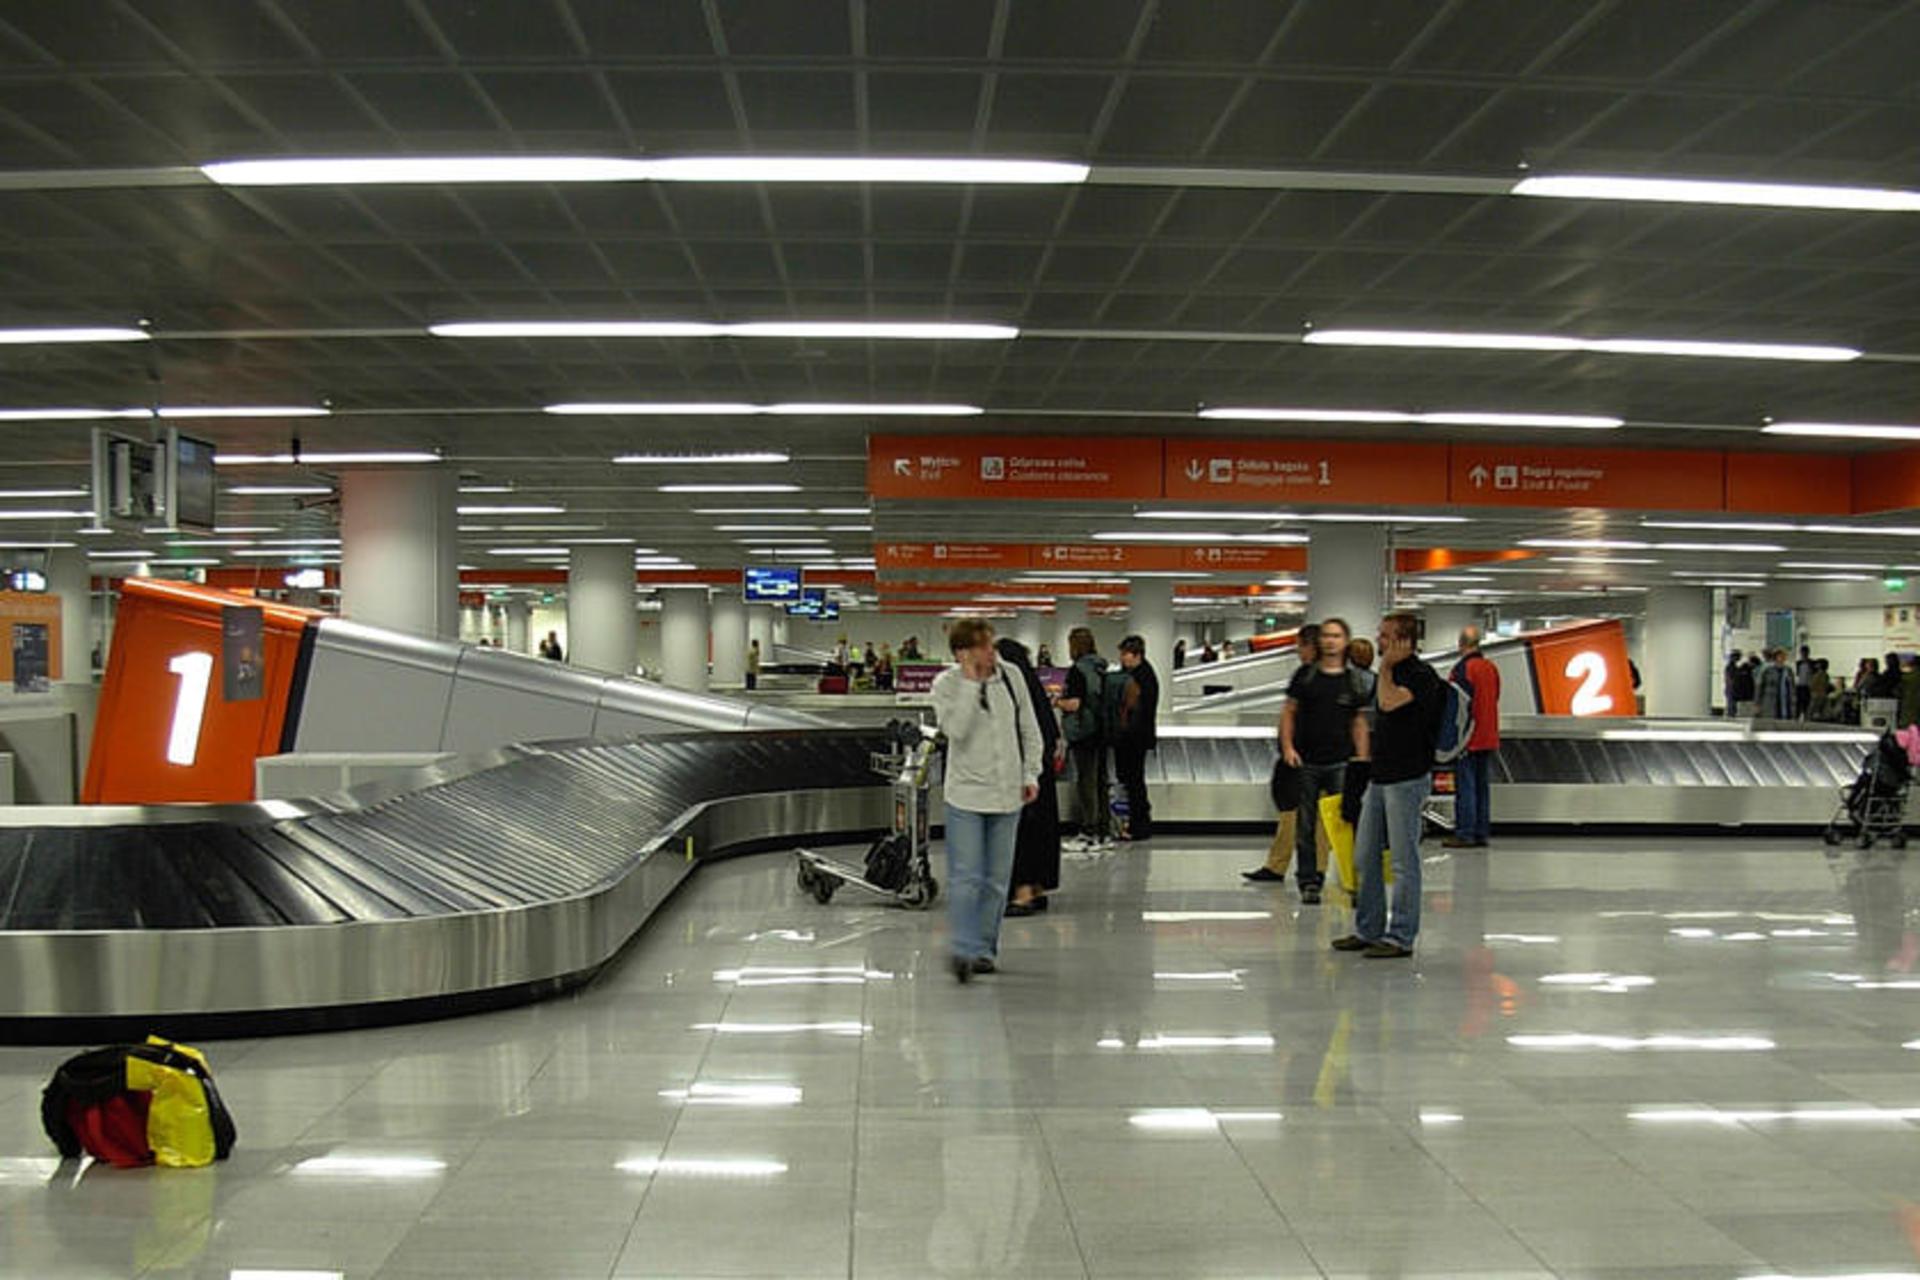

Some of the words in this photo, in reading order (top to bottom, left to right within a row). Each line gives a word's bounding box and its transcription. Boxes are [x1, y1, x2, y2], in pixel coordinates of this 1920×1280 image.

[1318, 461, 1330, 485] 1
[1112, 548, 1122, 560] 2
[1565, 652, 1613, 717] 2
[165, 651, 213, 766] 1
